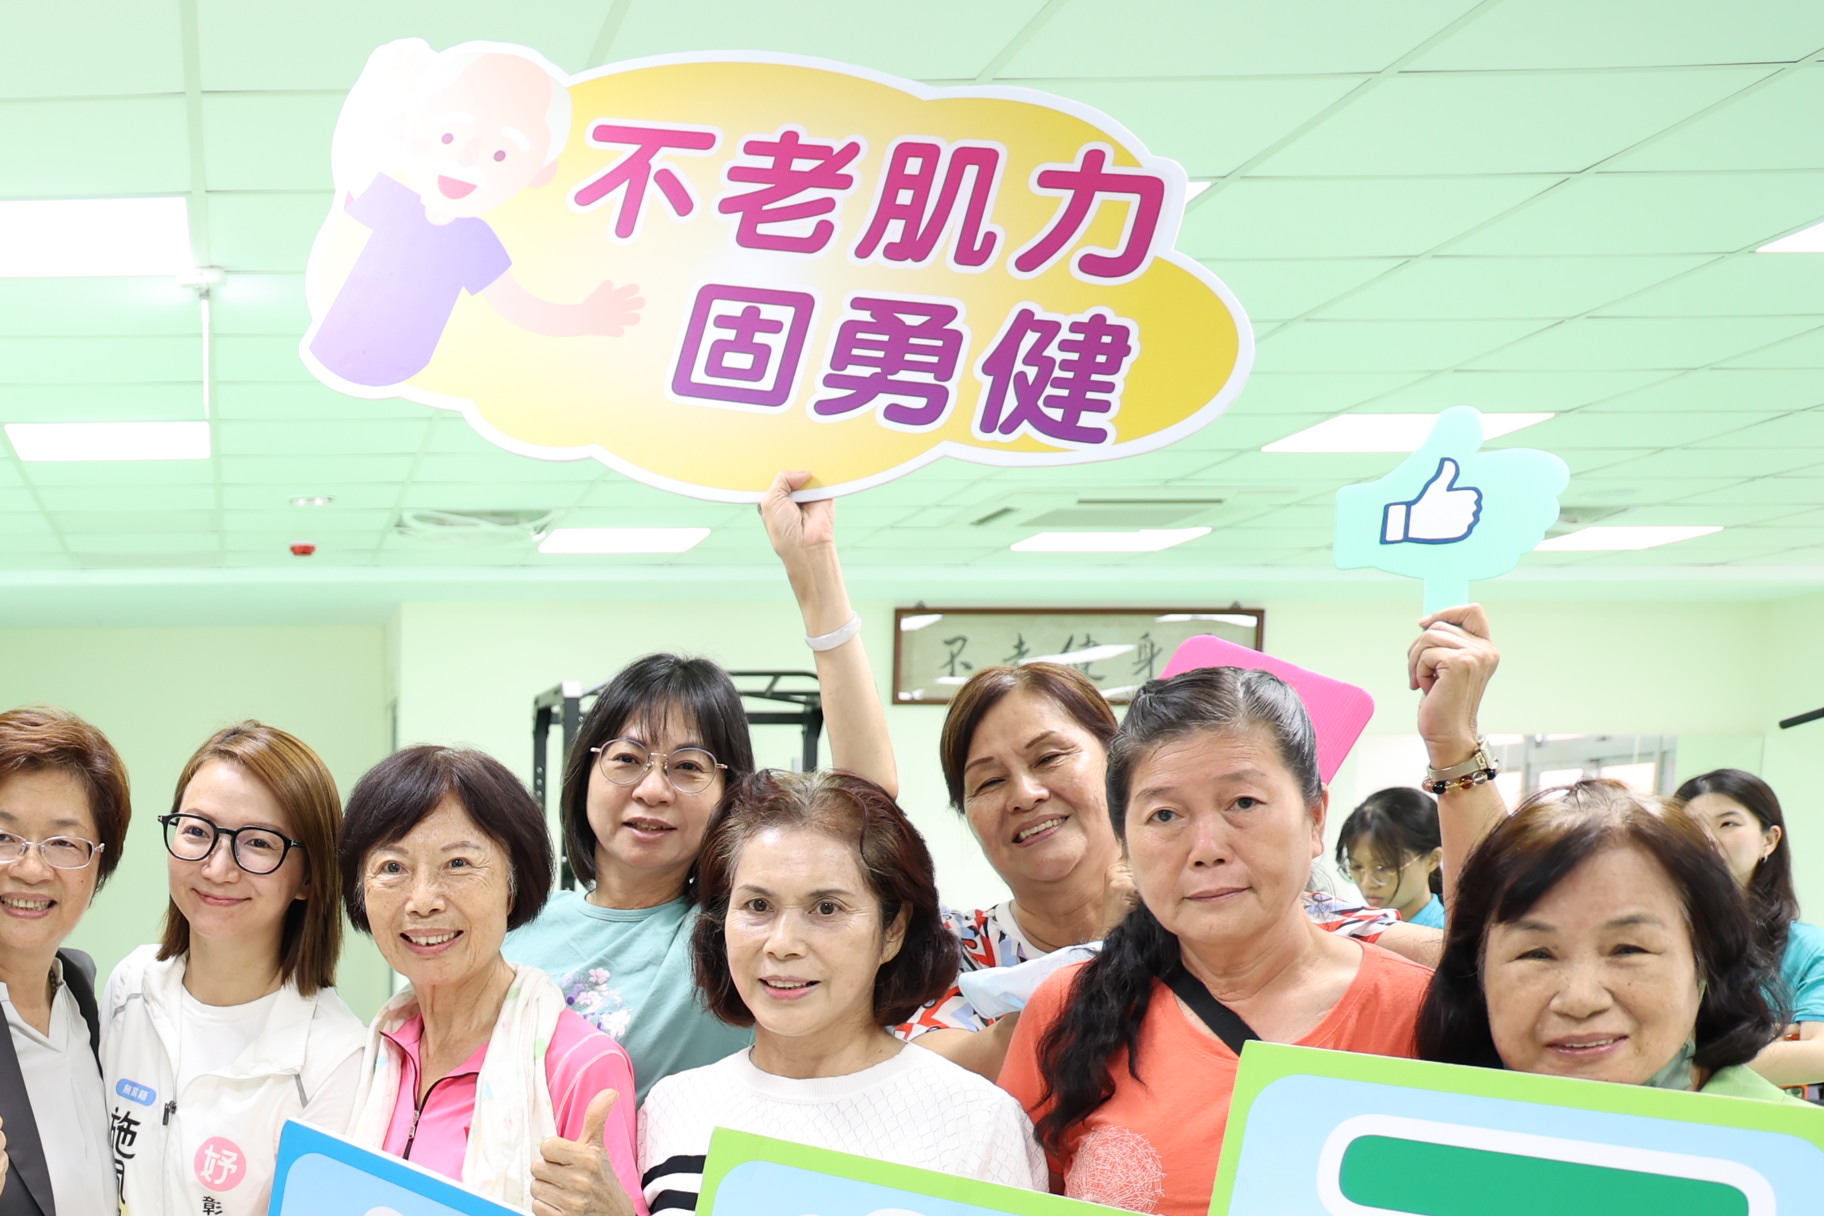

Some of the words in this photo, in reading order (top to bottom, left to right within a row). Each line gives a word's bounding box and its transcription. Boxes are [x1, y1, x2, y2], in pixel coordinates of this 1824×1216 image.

[574, 123, 1165, 278] 不老肌力
[670, 284, 1132, 444] 固勇健
[200, 1144, 238, 1185] 妤
